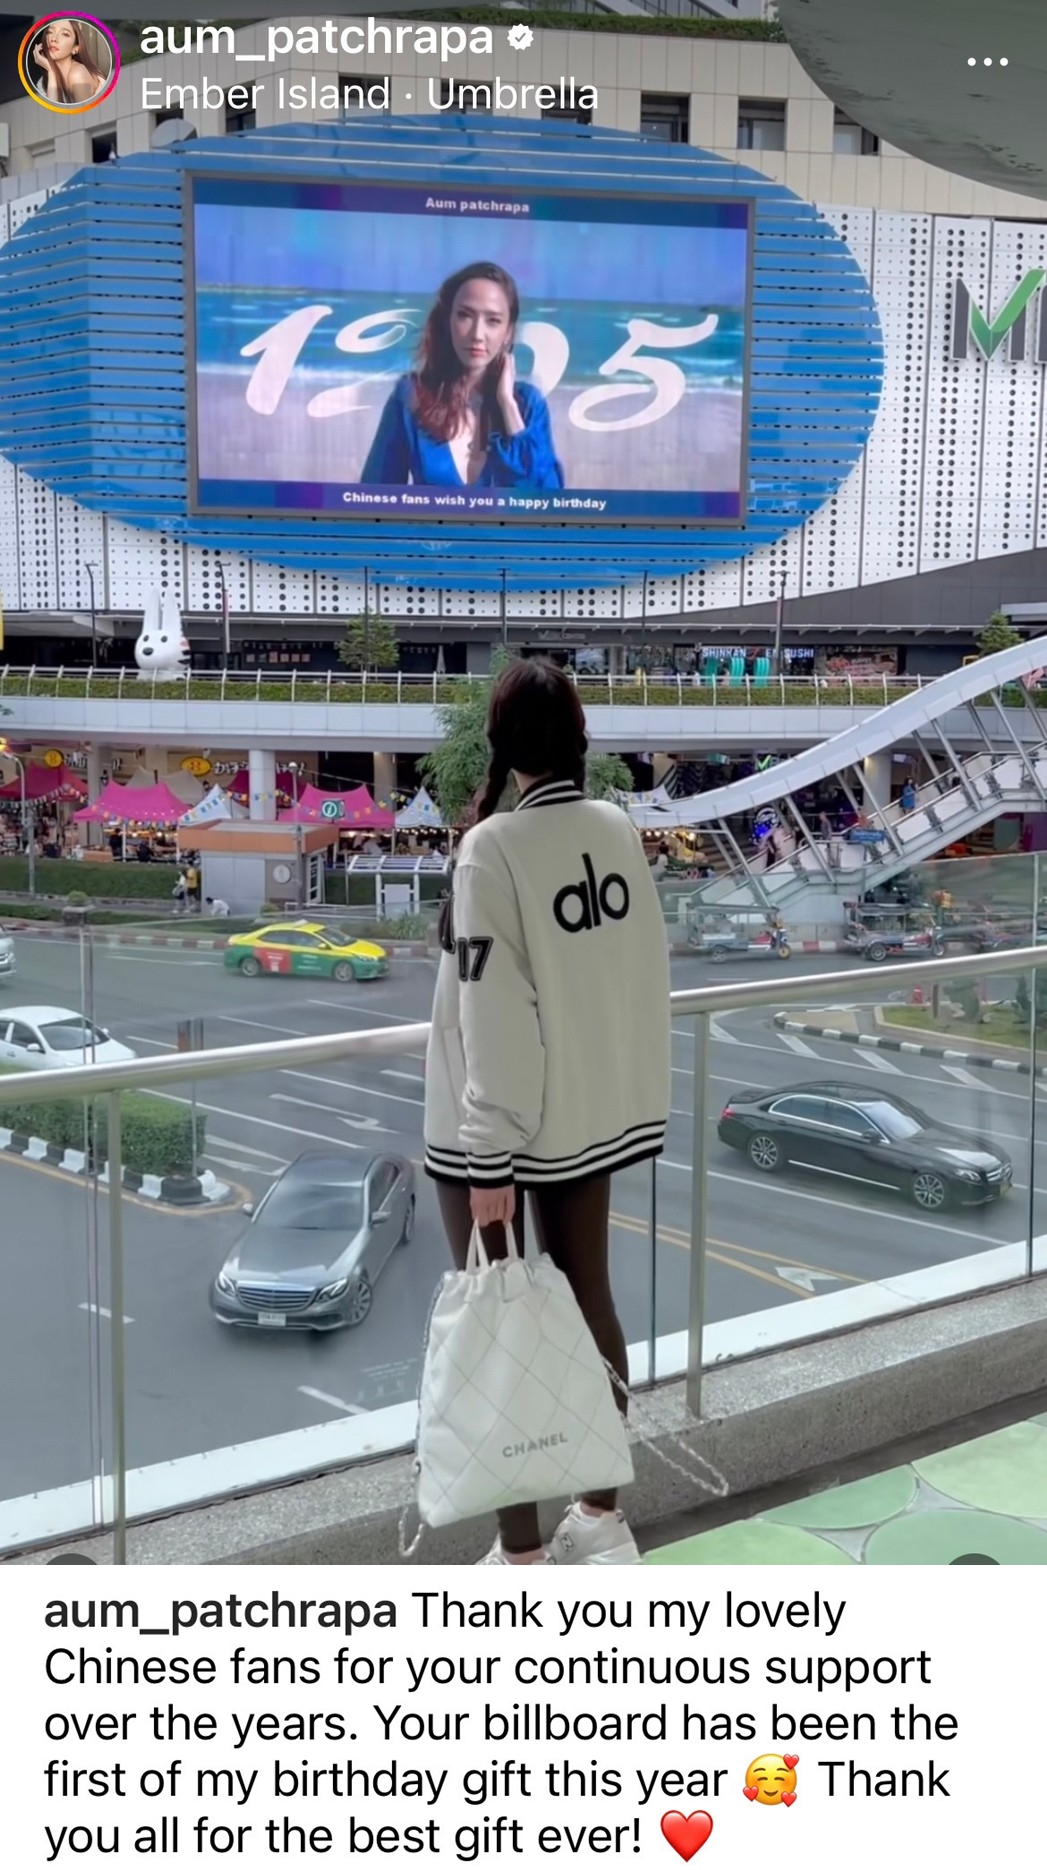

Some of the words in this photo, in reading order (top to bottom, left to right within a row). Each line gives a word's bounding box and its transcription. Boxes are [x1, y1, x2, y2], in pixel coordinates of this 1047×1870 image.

[425, 197, 456, 209] Aum
[460, 200, 530, 214] patchrapa
[342, 492, 397, 503] Chinese
[401, 493, 430, 505] fans
[434, 495, 465, 506] wish
[469, 497, 493, 508] you
[497, 498, 506, 506] a
[509, 497, 549, 509] happy
[553, 498, 607, 511] birthday
[783, 648, 815, 659] SUSHI
[552, 852, 630, 933] alo
[502, 1432, 569, 1458] CHANEL
